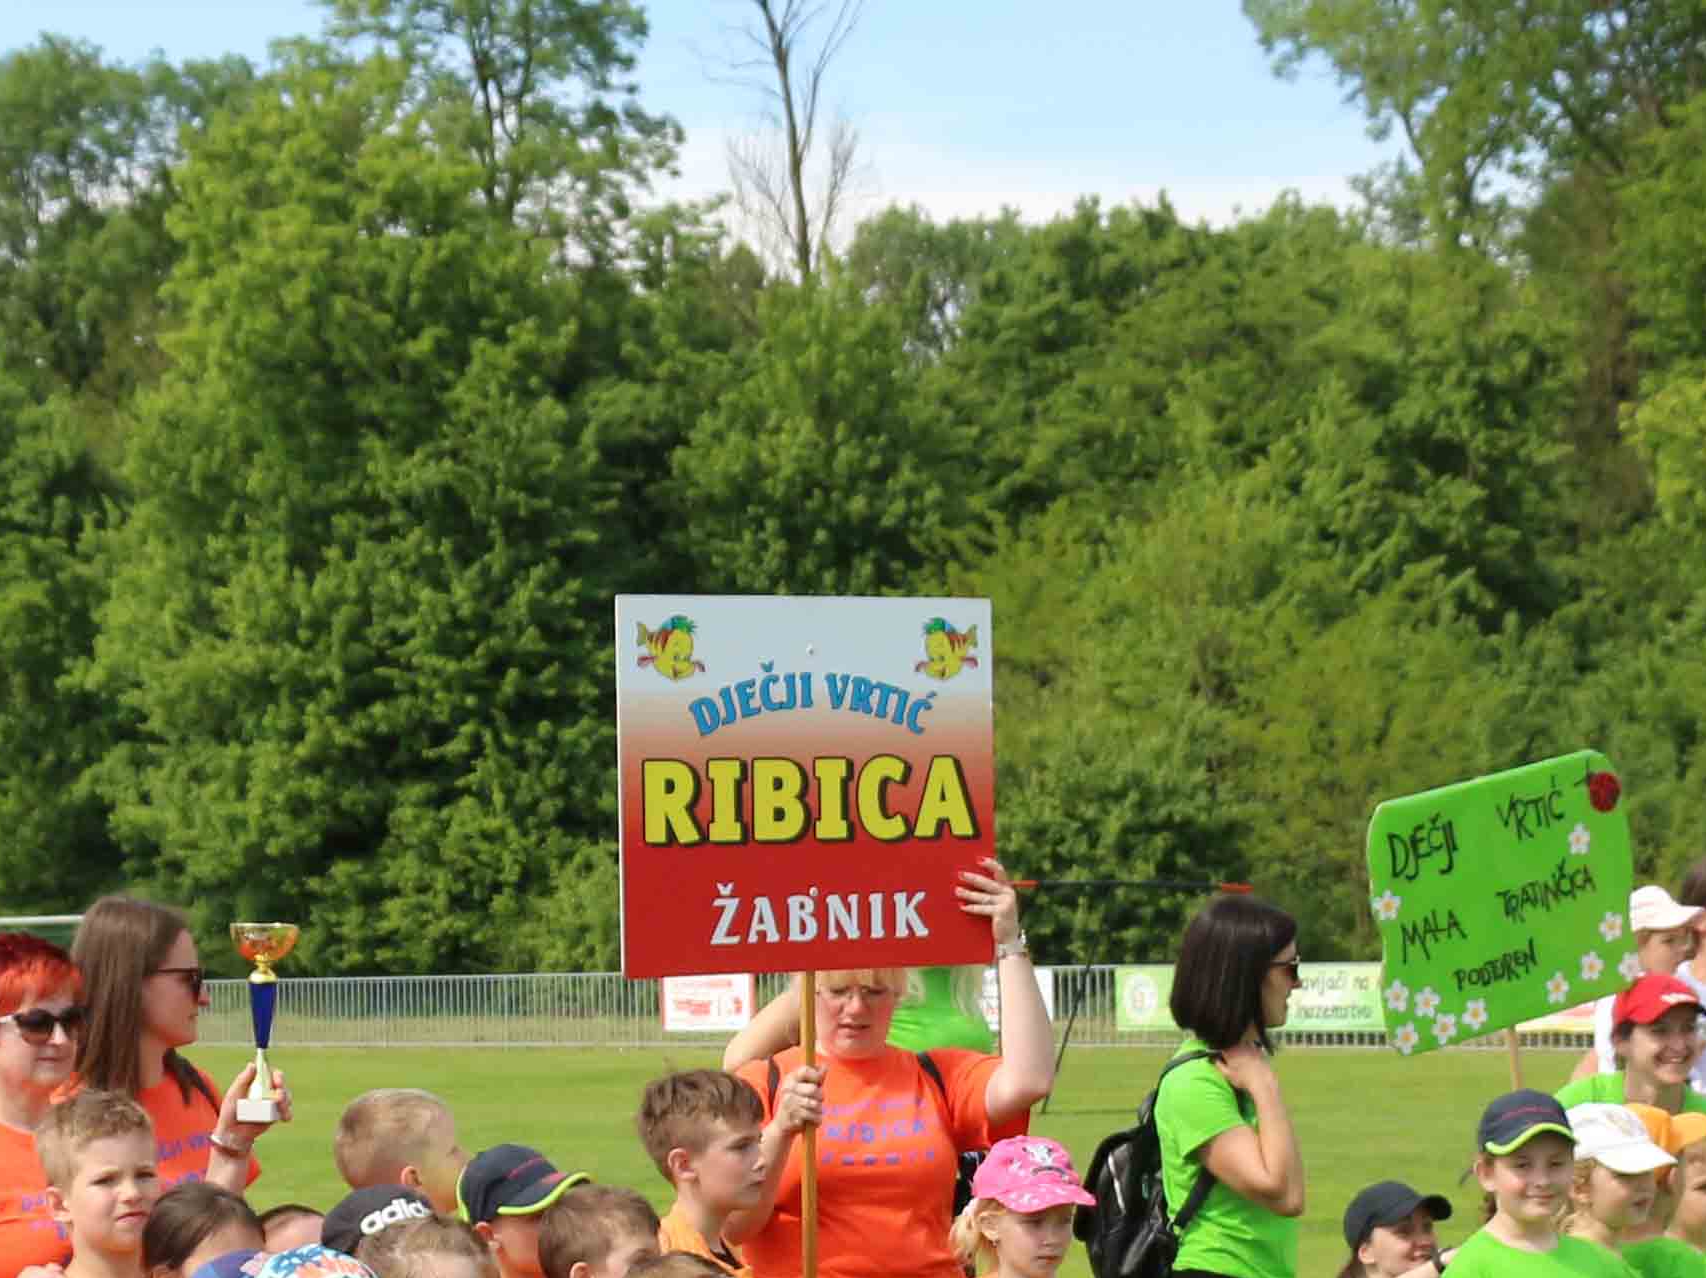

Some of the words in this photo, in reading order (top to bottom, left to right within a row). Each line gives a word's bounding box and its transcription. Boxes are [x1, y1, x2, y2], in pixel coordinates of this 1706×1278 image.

[688, 660, 815, 736] DJEČJI
[824, 671, 938, 736] VRTIĆ
[641, 754, 982, 847] RIBICA
[1386, 811, 1459, 881] DJEČJI
[1495, 775, 1566, 841] VRTIĆ
[709, 881, 929, 946] ŽABNIK
[1400, 907, 1468, 965] MALA
